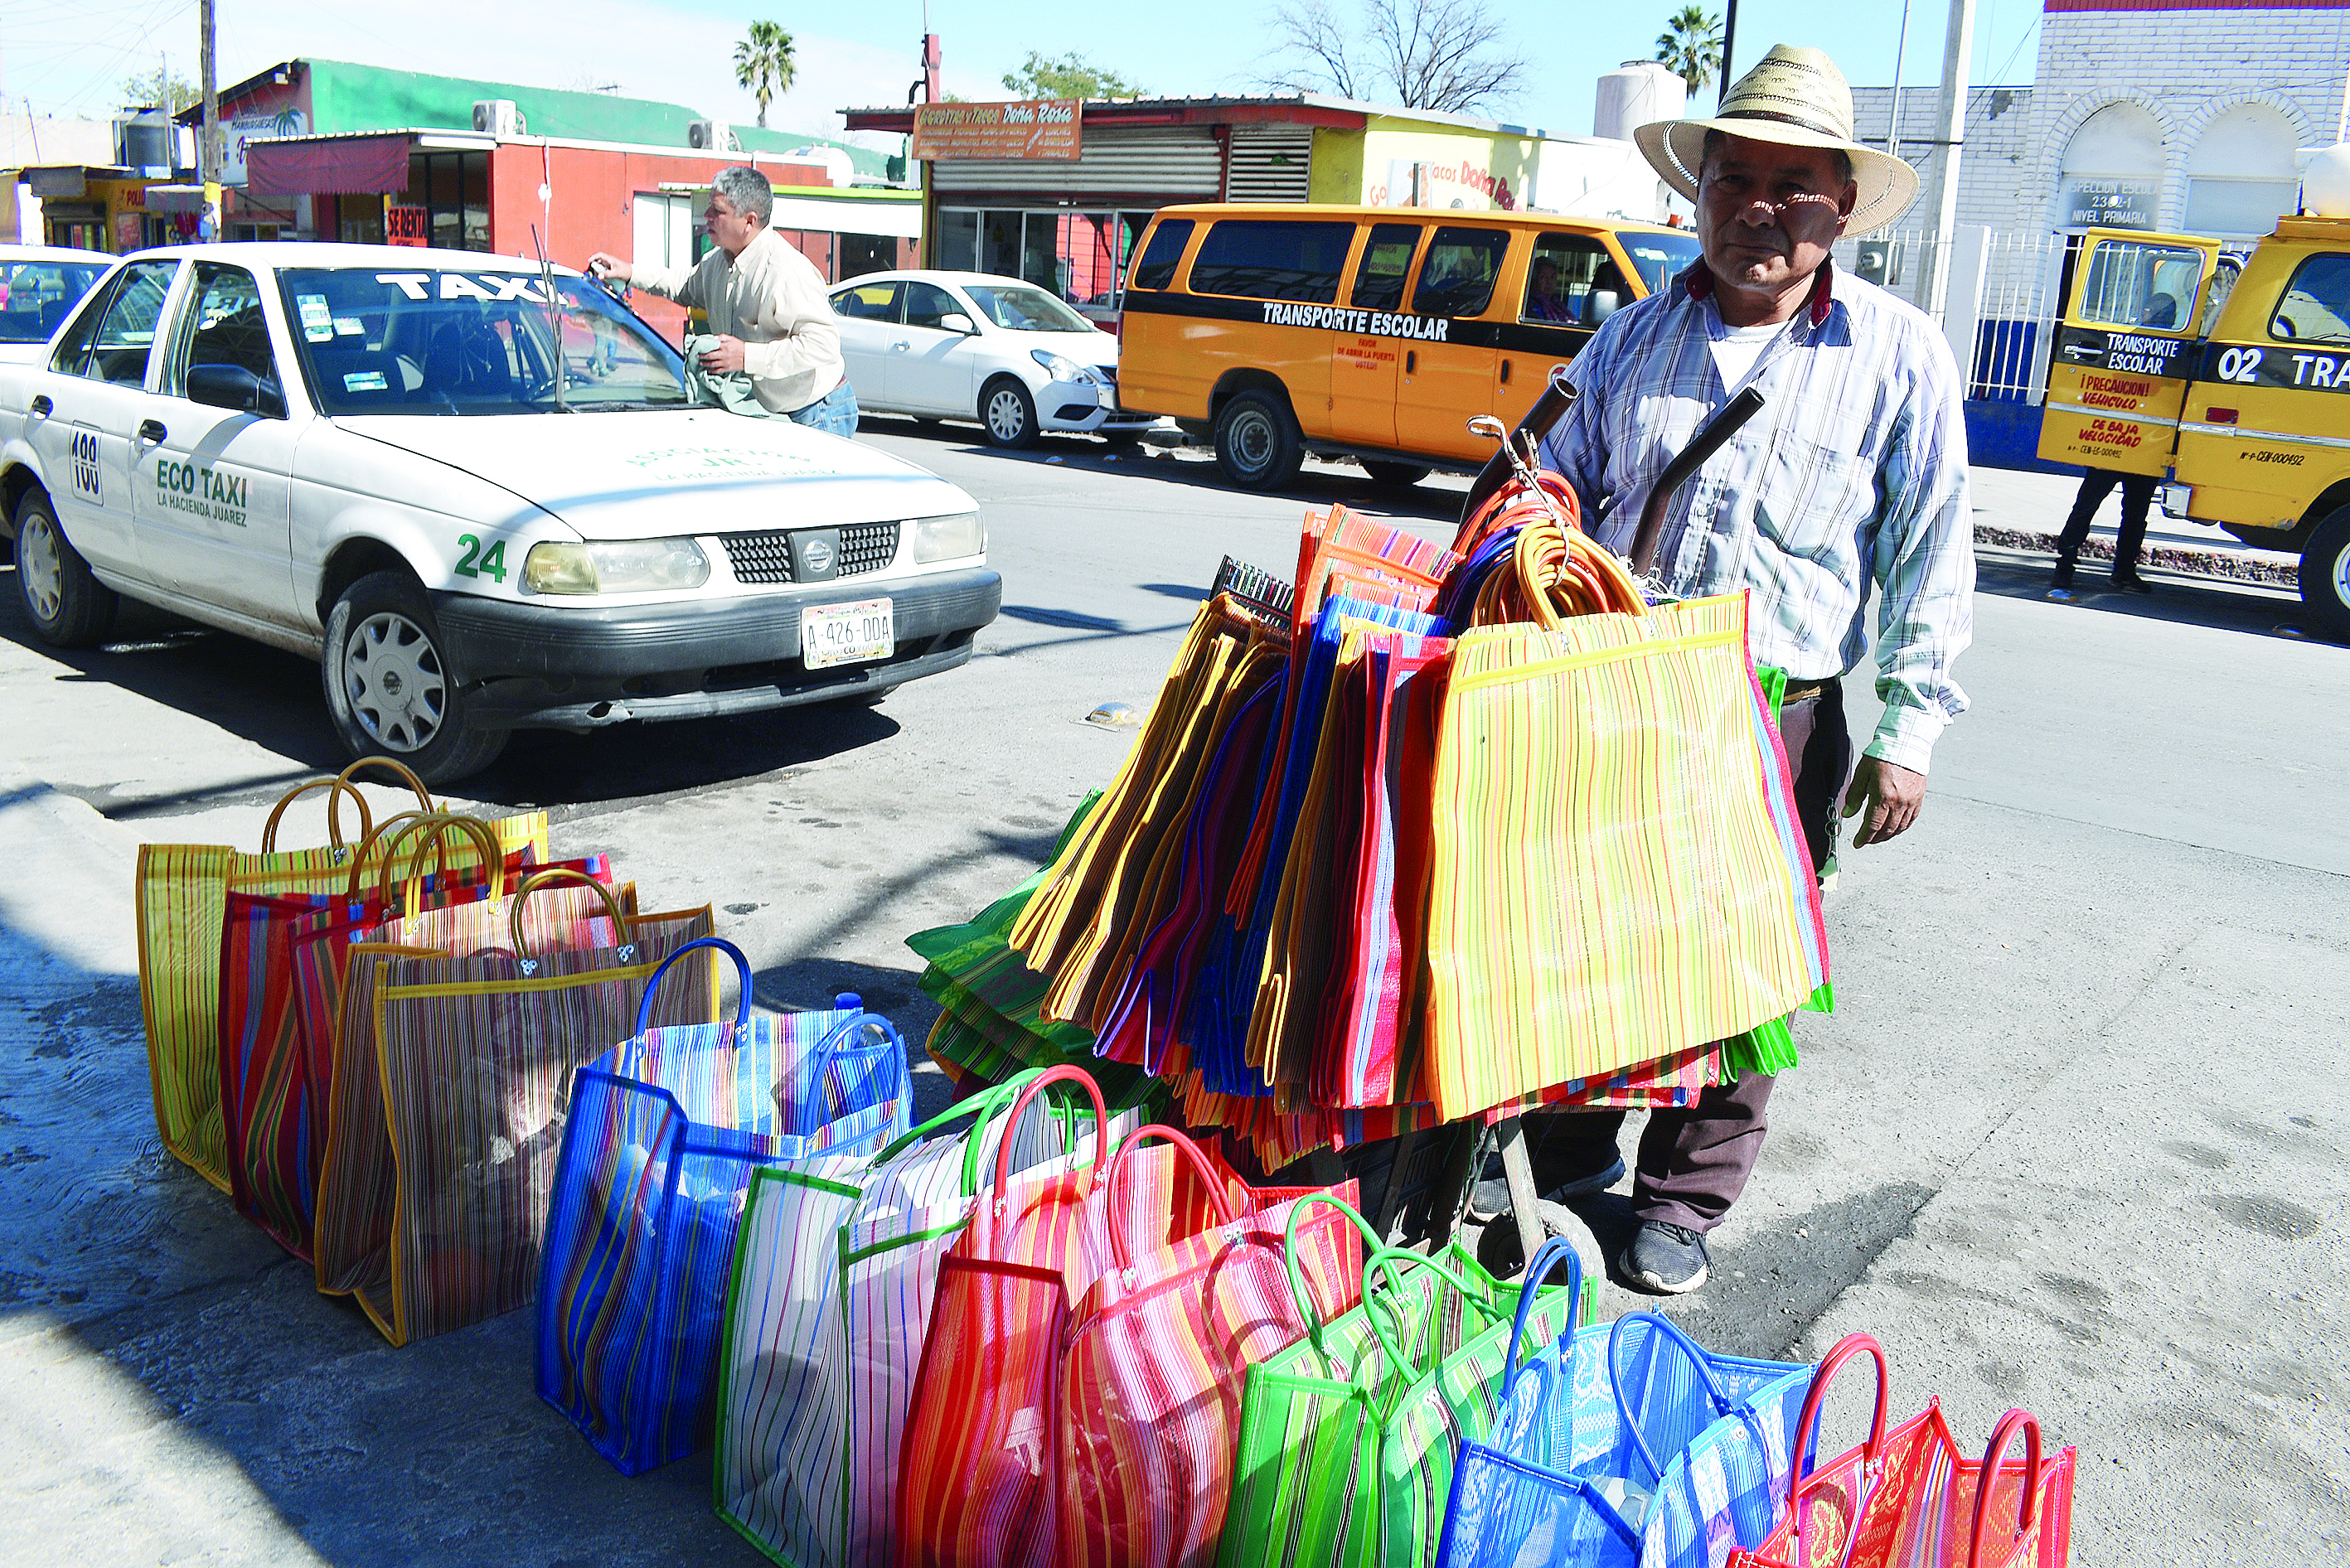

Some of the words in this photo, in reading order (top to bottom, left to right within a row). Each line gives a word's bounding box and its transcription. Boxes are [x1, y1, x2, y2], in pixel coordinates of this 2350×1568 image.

[1001, 103, 1034, 123] Doña
[1036, 102, 1073, 123] Rosa
[1432, 161, 1458, 182] acos
[1461, 160, 1495, 197] Doña
[1495, 177, 1523, 212] Ros
[2071, 181, 2117, 194] SPECCION
[2122, 182, 2157, 195] ESCOLA
[388, 208, 400, 237] SE
[400, 207, 428, 238] RENTA
[2072, 210, 2099, 222] NIVEL
[2103, 211, 2146, 224] PRIMARIA
[375, 273, 569, 305] TAXI
[1263, 302, 1368, 333] TRANSPORTE
[1370, 312, 1449, 341] ESCOLAR
[1337, 346, 1345, 355] DE
[1346, 348, 1363, 357] ABRIR
[1364, 351, 1371, 359] LA
[1373, 351, 1395, 361] PUERTA
[1359, 338, 1377, 347] FAVOR
[2107, 332, 2179, 357] TRANSPORTE
[2107, 352, 2163, 375] ESCOLAR
[2218, 347, 2262, 382] 02
[2082, 392, 2137, 409] VEHICULO
[2079, 428, 2141, 448] VELOCIDAD
[2091, 419, 2106, 429] DE
[2107, 422, 2139, 436] BAJA
[157, 458, 195, 495] ECO
[201, 467, 247, 507] TAXI
[157, 492, 168, 506] LA
[170, 496, 211, 517] HACIENDA
[213, 505, 247, 527] JUAREZ
[454, 534, 506, 583] 24
